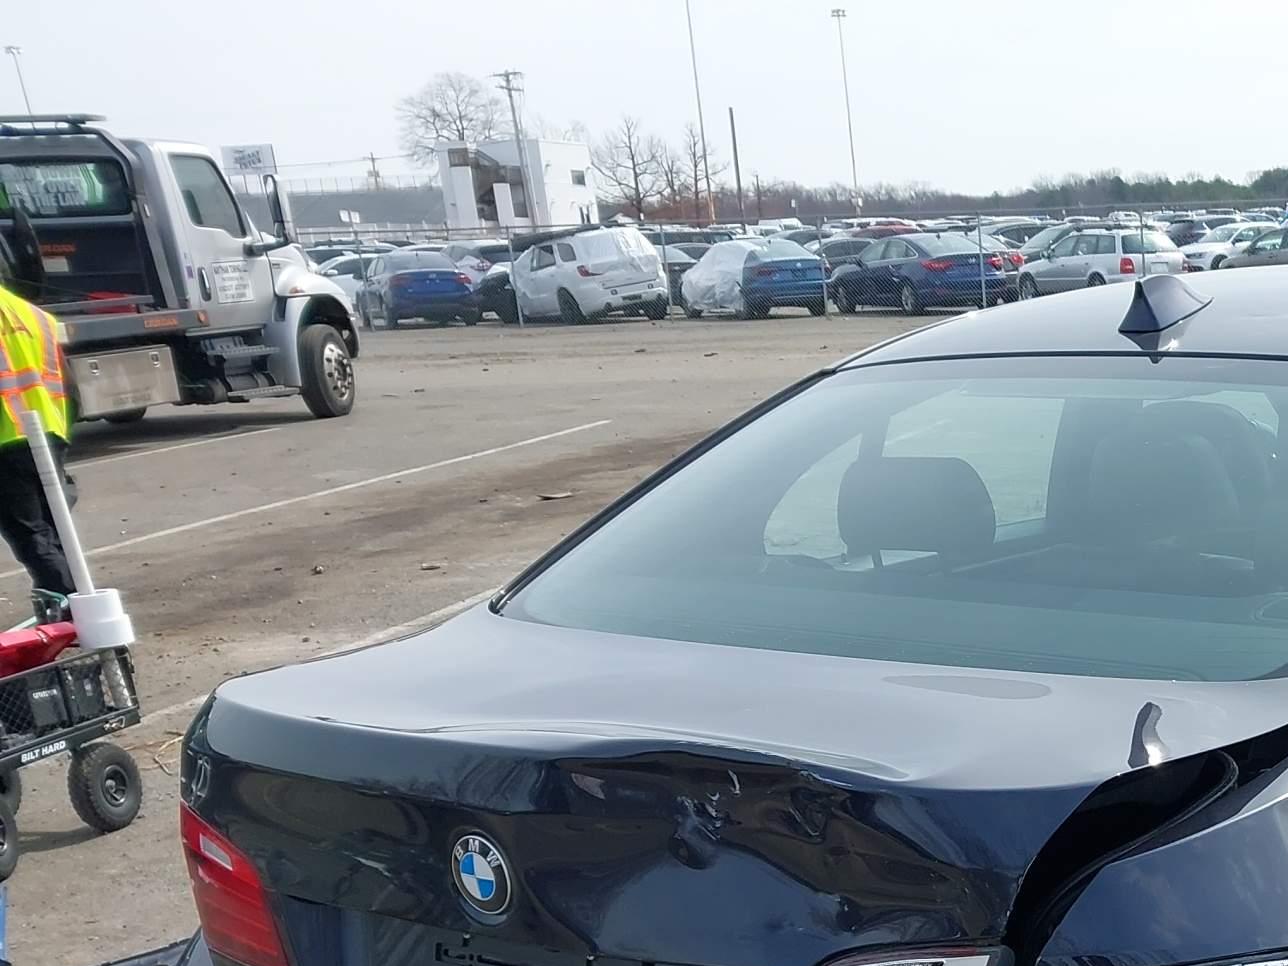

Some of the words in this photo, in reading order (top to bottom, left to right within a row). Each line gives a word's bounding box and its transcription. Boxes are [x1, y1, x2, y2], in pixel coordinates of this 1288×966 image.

[21, 749, 40, 763] BILT
[41, 740, 66, 756] HARD
[455, 838, 500, 868] BMW
